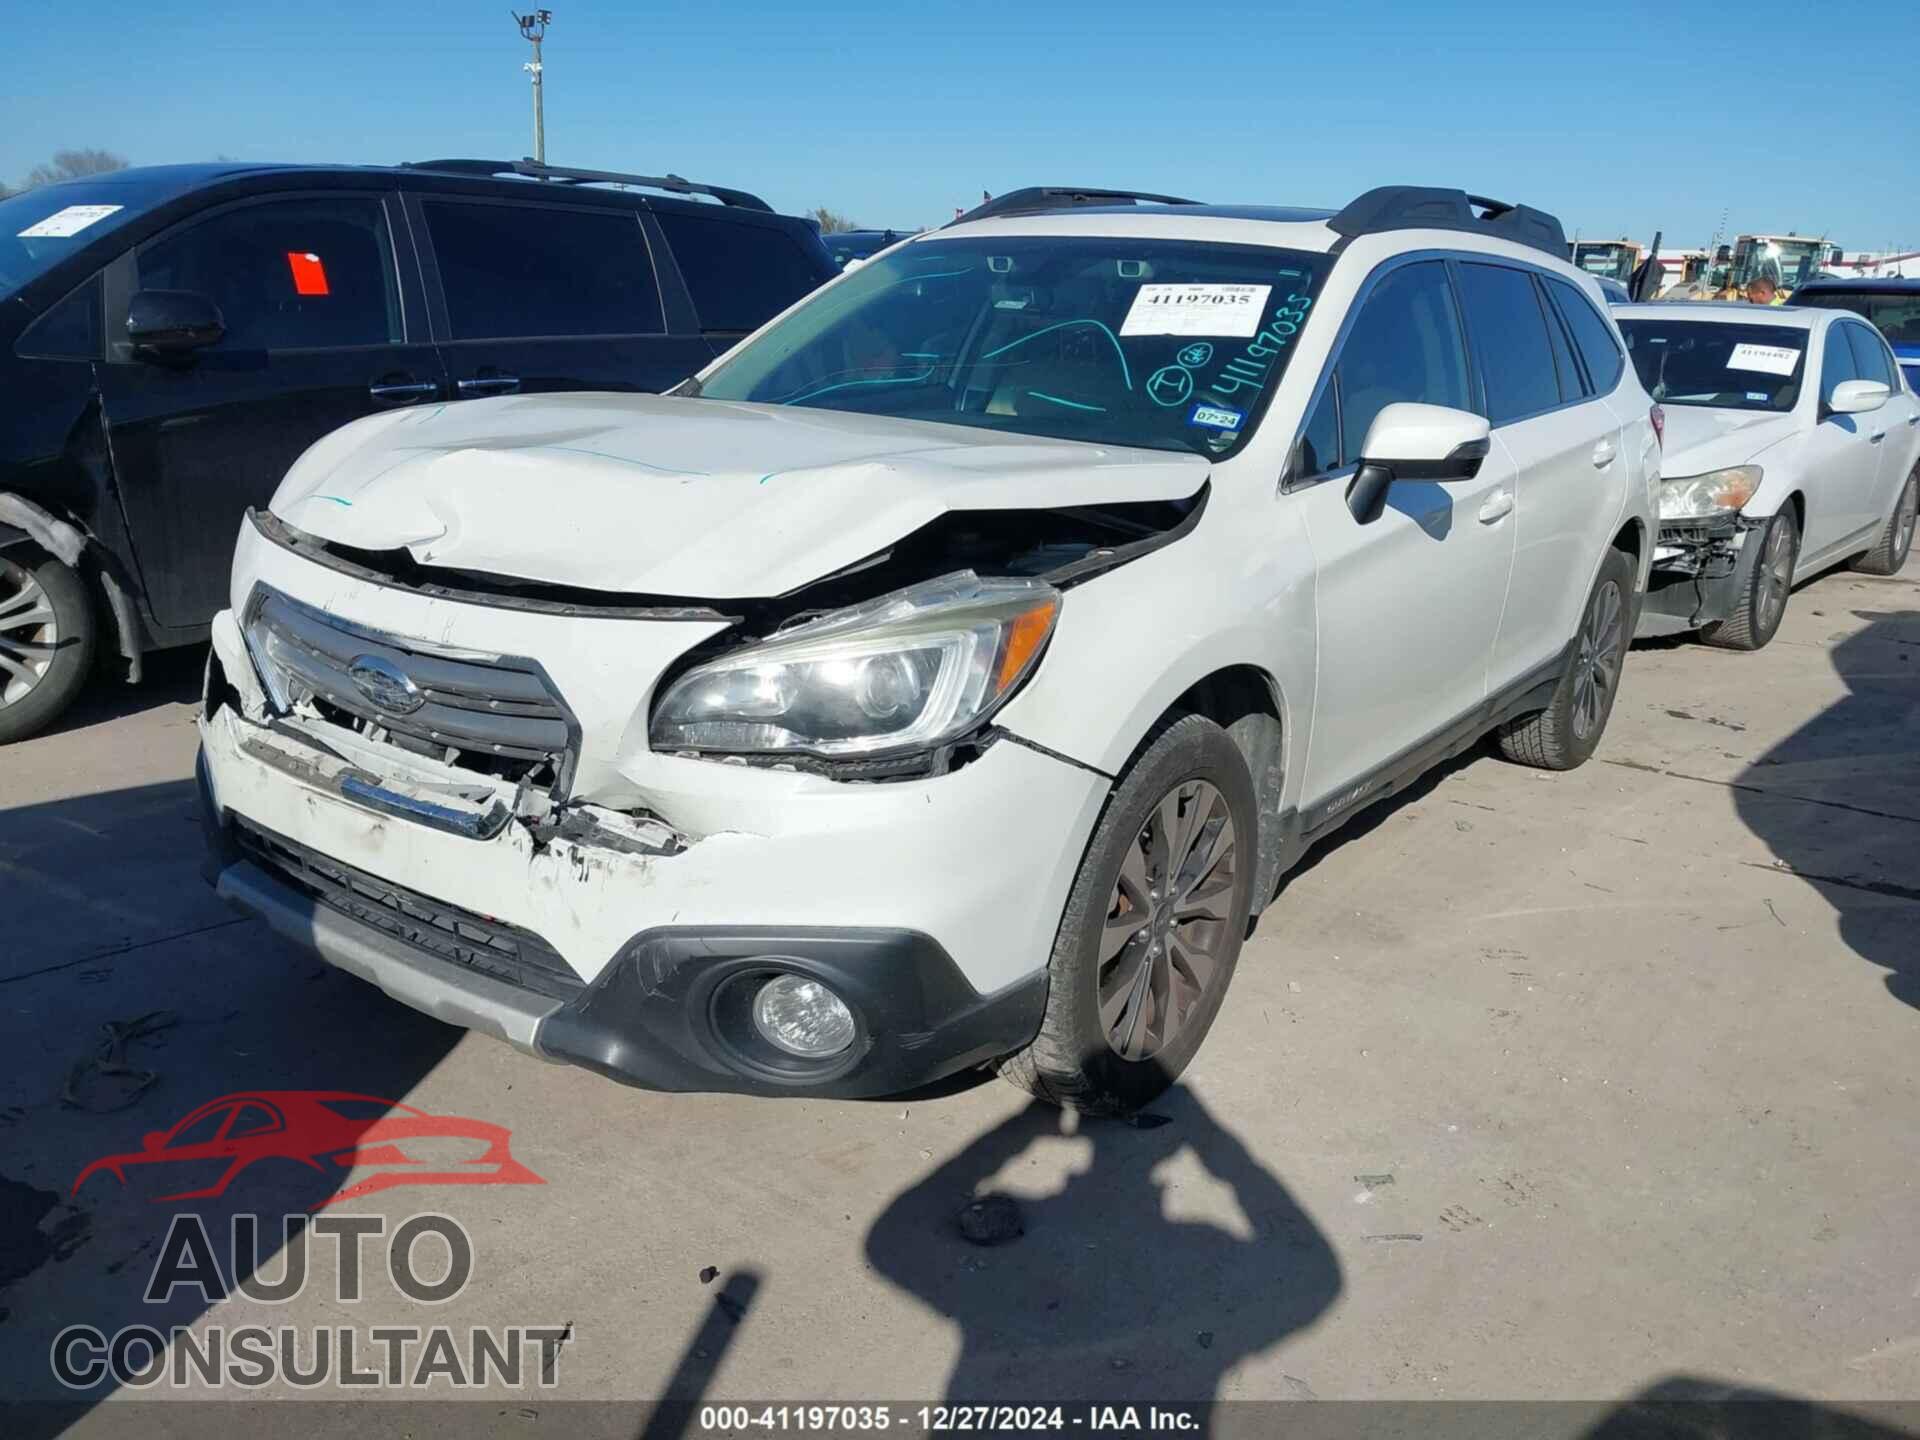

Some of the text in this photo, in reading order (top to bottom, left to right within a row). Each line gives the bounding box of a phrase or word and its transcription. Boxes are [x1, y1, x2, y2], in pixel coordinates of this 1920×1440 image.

[1147, 293, 1252, 305] 41197035
[1211, 294, 1312, 393] 41197035
[1196, 410, 1237, 426] 07-24
